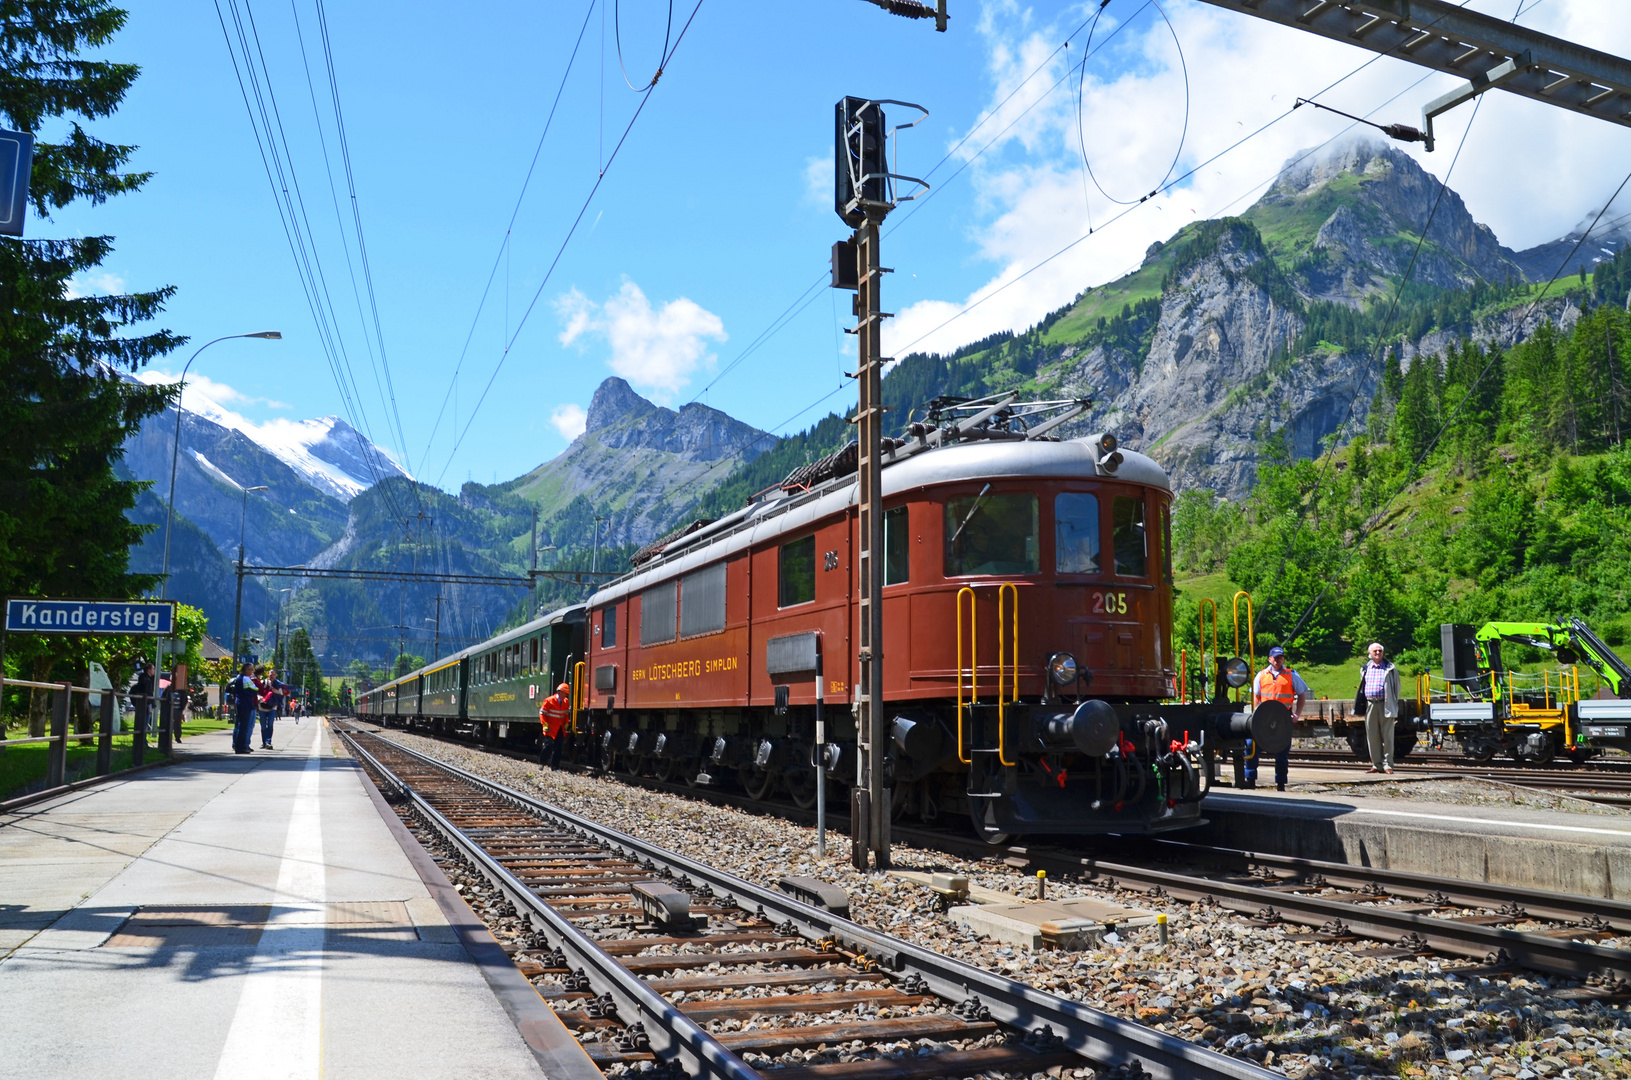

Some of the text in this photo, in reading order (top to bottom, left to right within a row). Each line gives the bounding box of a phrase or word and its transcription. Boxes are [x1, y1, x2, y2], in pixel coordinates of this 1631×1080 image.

[824, 550, 838, 572] 205
[1092, 592, 1127, 615] 205
[21, 604, 159, 631] Kandersteg
[632, 656, 738, 681] BERN LÖTSCHBERG SIMPLON
